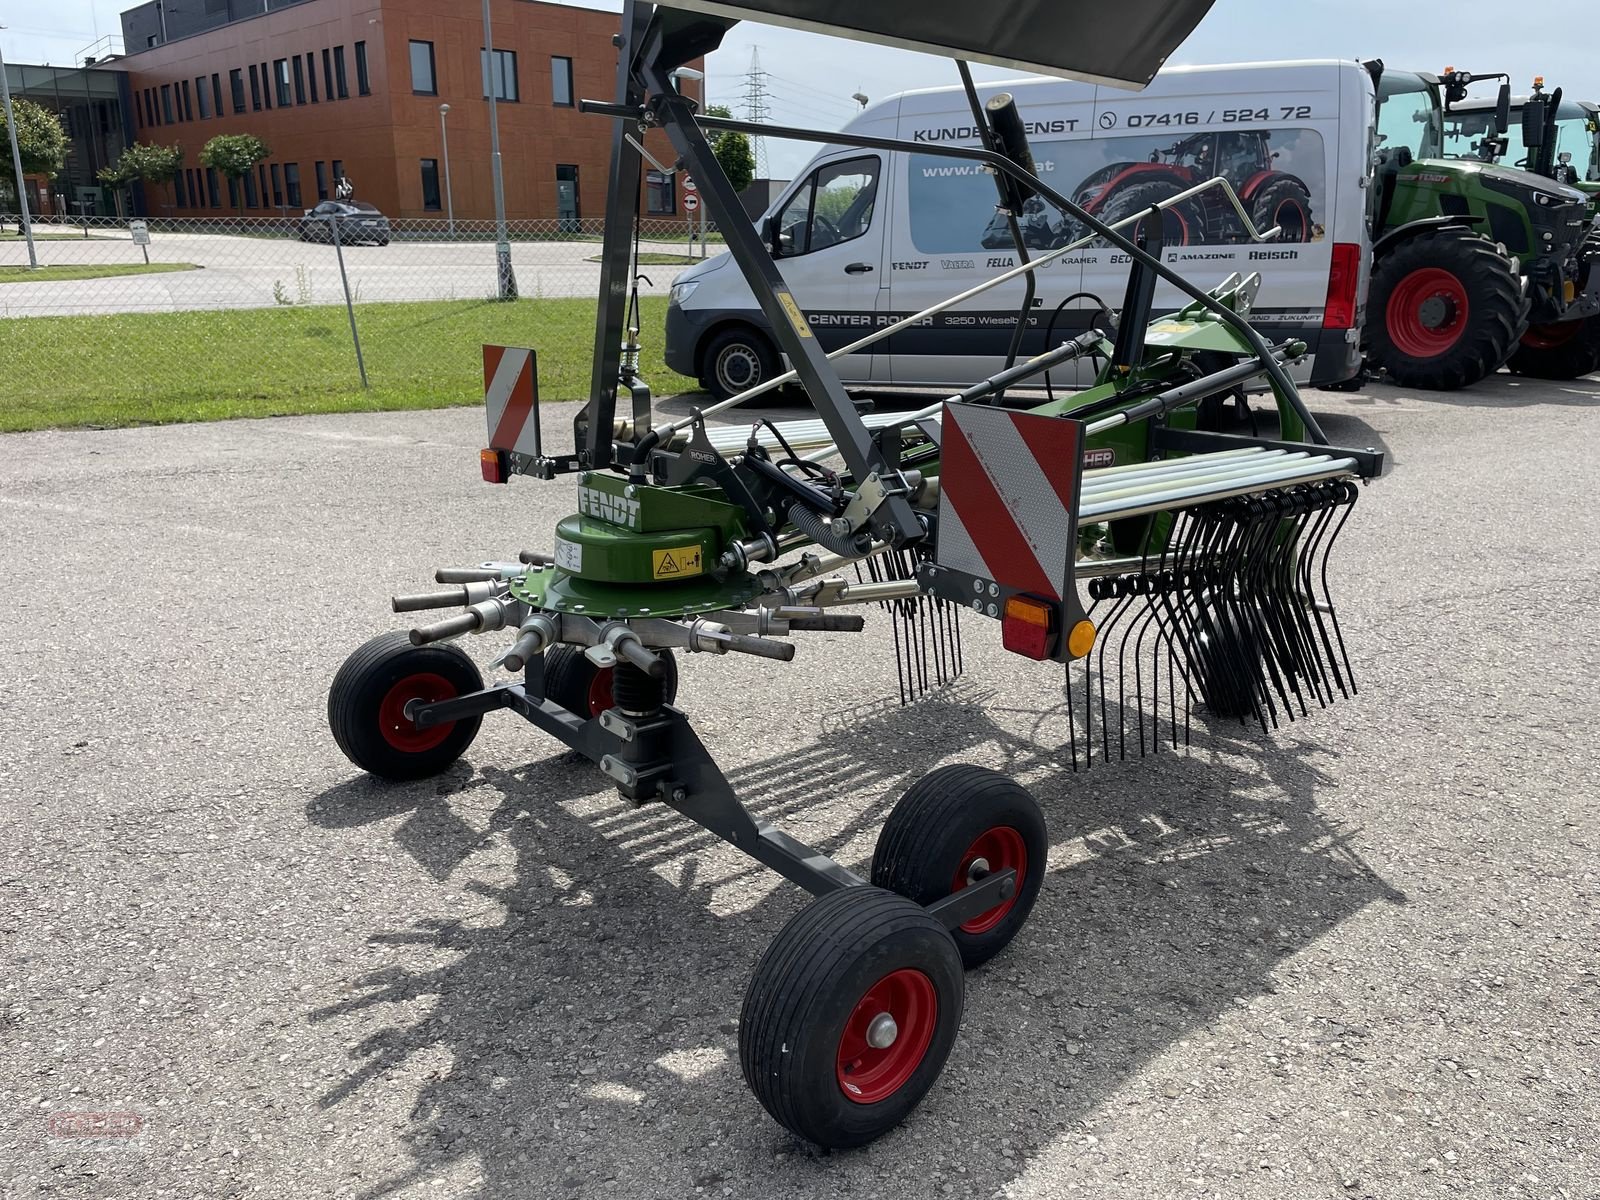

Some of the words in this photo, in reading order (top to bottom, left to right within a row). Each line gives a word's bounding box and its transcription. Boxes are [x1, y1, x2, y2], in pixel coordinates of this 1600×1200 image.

[914, 119, 1079, 141] KUNDEENST
[1127, 112, 1199, 127] 07416
[1222, 108, 1270, 122] 524
[1280, 106, 1311, 119] 72
[891, 261, 930, 270] FENDT
[986, 257, 1014, 268] FELLA
[1062, 257, 1098, 265] KRAMER
[1110, 255, 1133, 264] BED
[1180, 253, 1236, 261] AMAZONE
[1249, 250, 1299, 261] Reisch
[808, 314, 871, 326] CENTER
[876, 315, 933, 326] ROER
[945, 316, 976, 325] 3250
[979, 316, 1038, 325] Wieselbrg
[690, 451, 716, 463] ROHER
[1083, 452, 1112, 467] HER
[578, 486, 641, 528] FENDT
